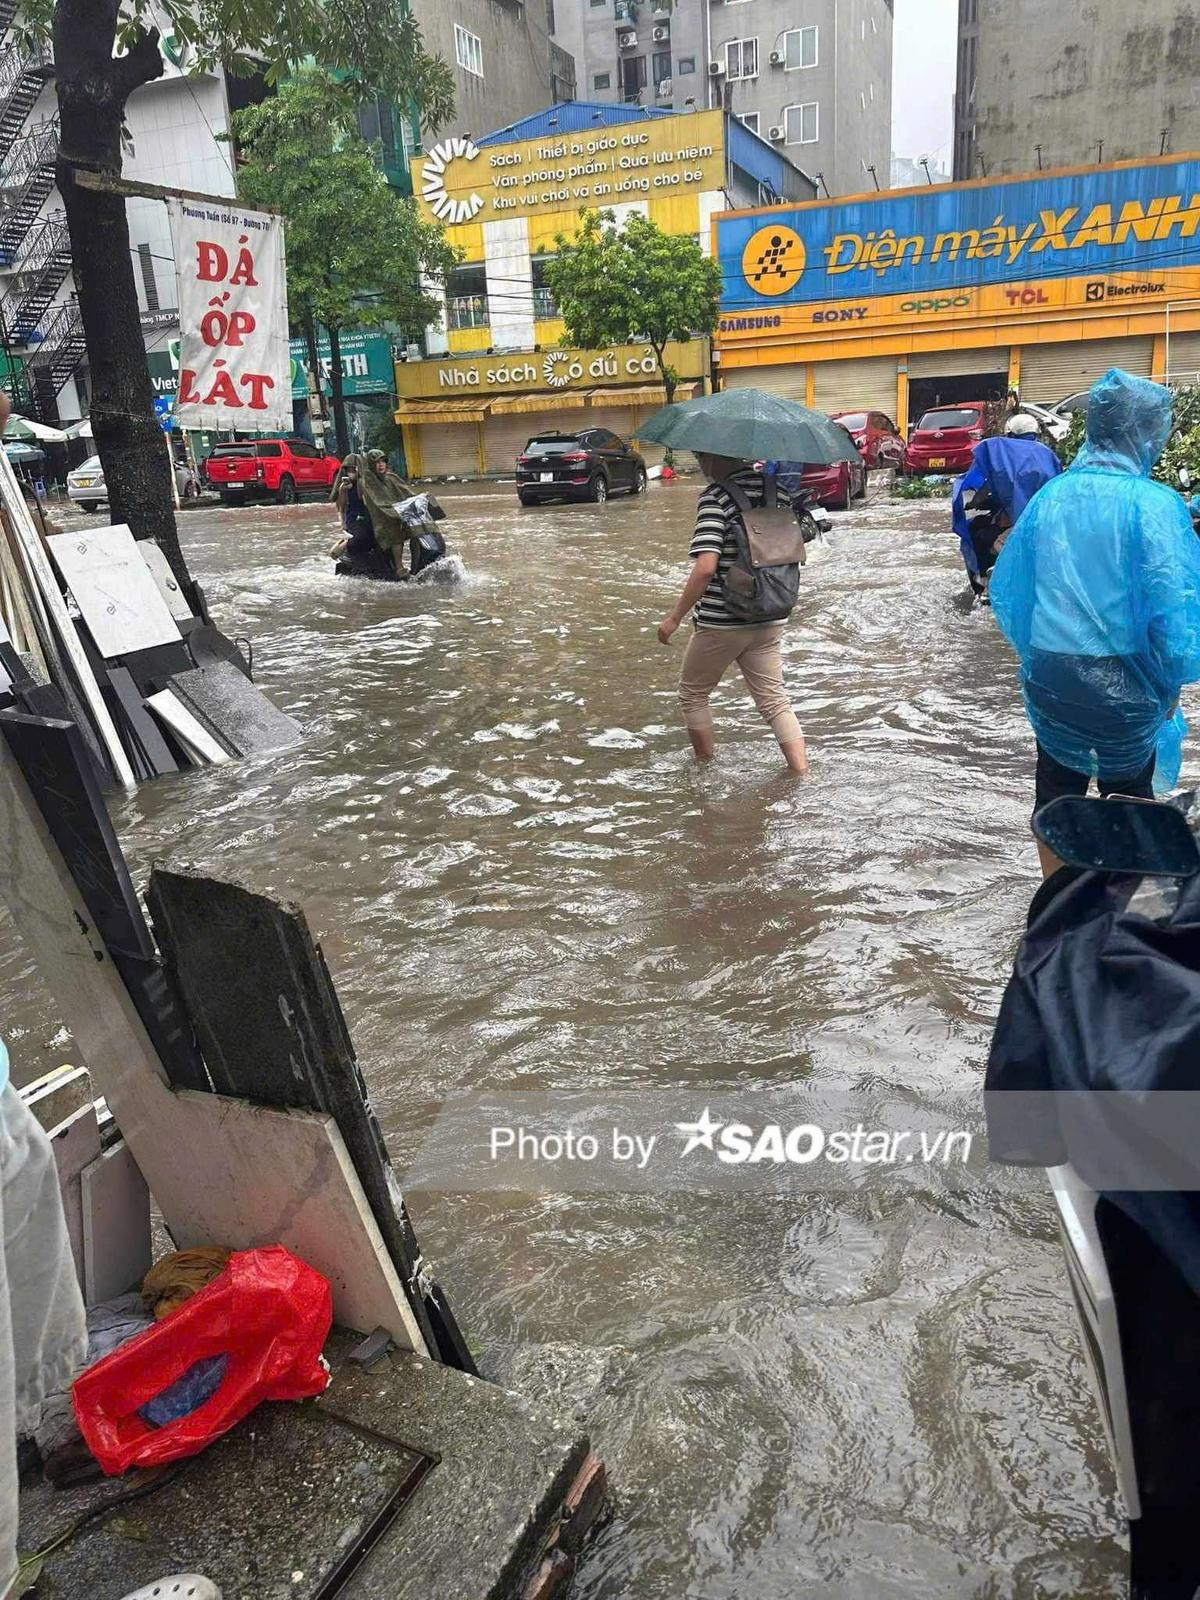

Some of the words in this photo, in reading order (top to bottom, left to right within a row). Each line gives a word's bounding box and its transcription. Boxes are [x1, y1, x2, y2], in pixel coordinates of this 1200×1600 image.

[489, 151, 522, 167] Sách
[537, 142, 567, 159] Thiết
[571, 142, 583, 157] bị
[586, 134, 617, 154] giáo
[621, 132, 649, 148] dục
[492, 174, 518, 187] Văn
[523, 168, 565, 185] phòng
[568, 158, 607, 179] phẩm
[653, 151, 673, 164] lưu
[677, 145, 712, 162] niệm
[493, 196, 516, 209] Khu
[520, 194, 538, 205] vui
[541, 187, 569, 202] chơi
[573, 184, 589, 198] và
[593, 182, 611, 196] ăn
[615, 174, 650, 191] uống
[653, 173, 680, 187] cho
[684, 166, 703, 182] bé
[195, 234, 259, 286] ĐÁ
[823, 229, 926, 277] Điện
[929, 214, 1038, 265] máy
[1028, 193, 1200, 253] XANH
[200, 291, 256, 347] ỐP
[719, 314, 781, 332] SAMSUNG
[812, 307, 868, 323] SONY
[1005, 288, 1049, 306] TCL
[1107, 282, 1166, 297] Electrolux
[178, 359, 275, 410] LÁT
[439, 366, 480, 386] Nhà
[486, 363, 537, 384] sách
[589, 351, 618, 378] đủ
[625, 348, 656, 374] cả
